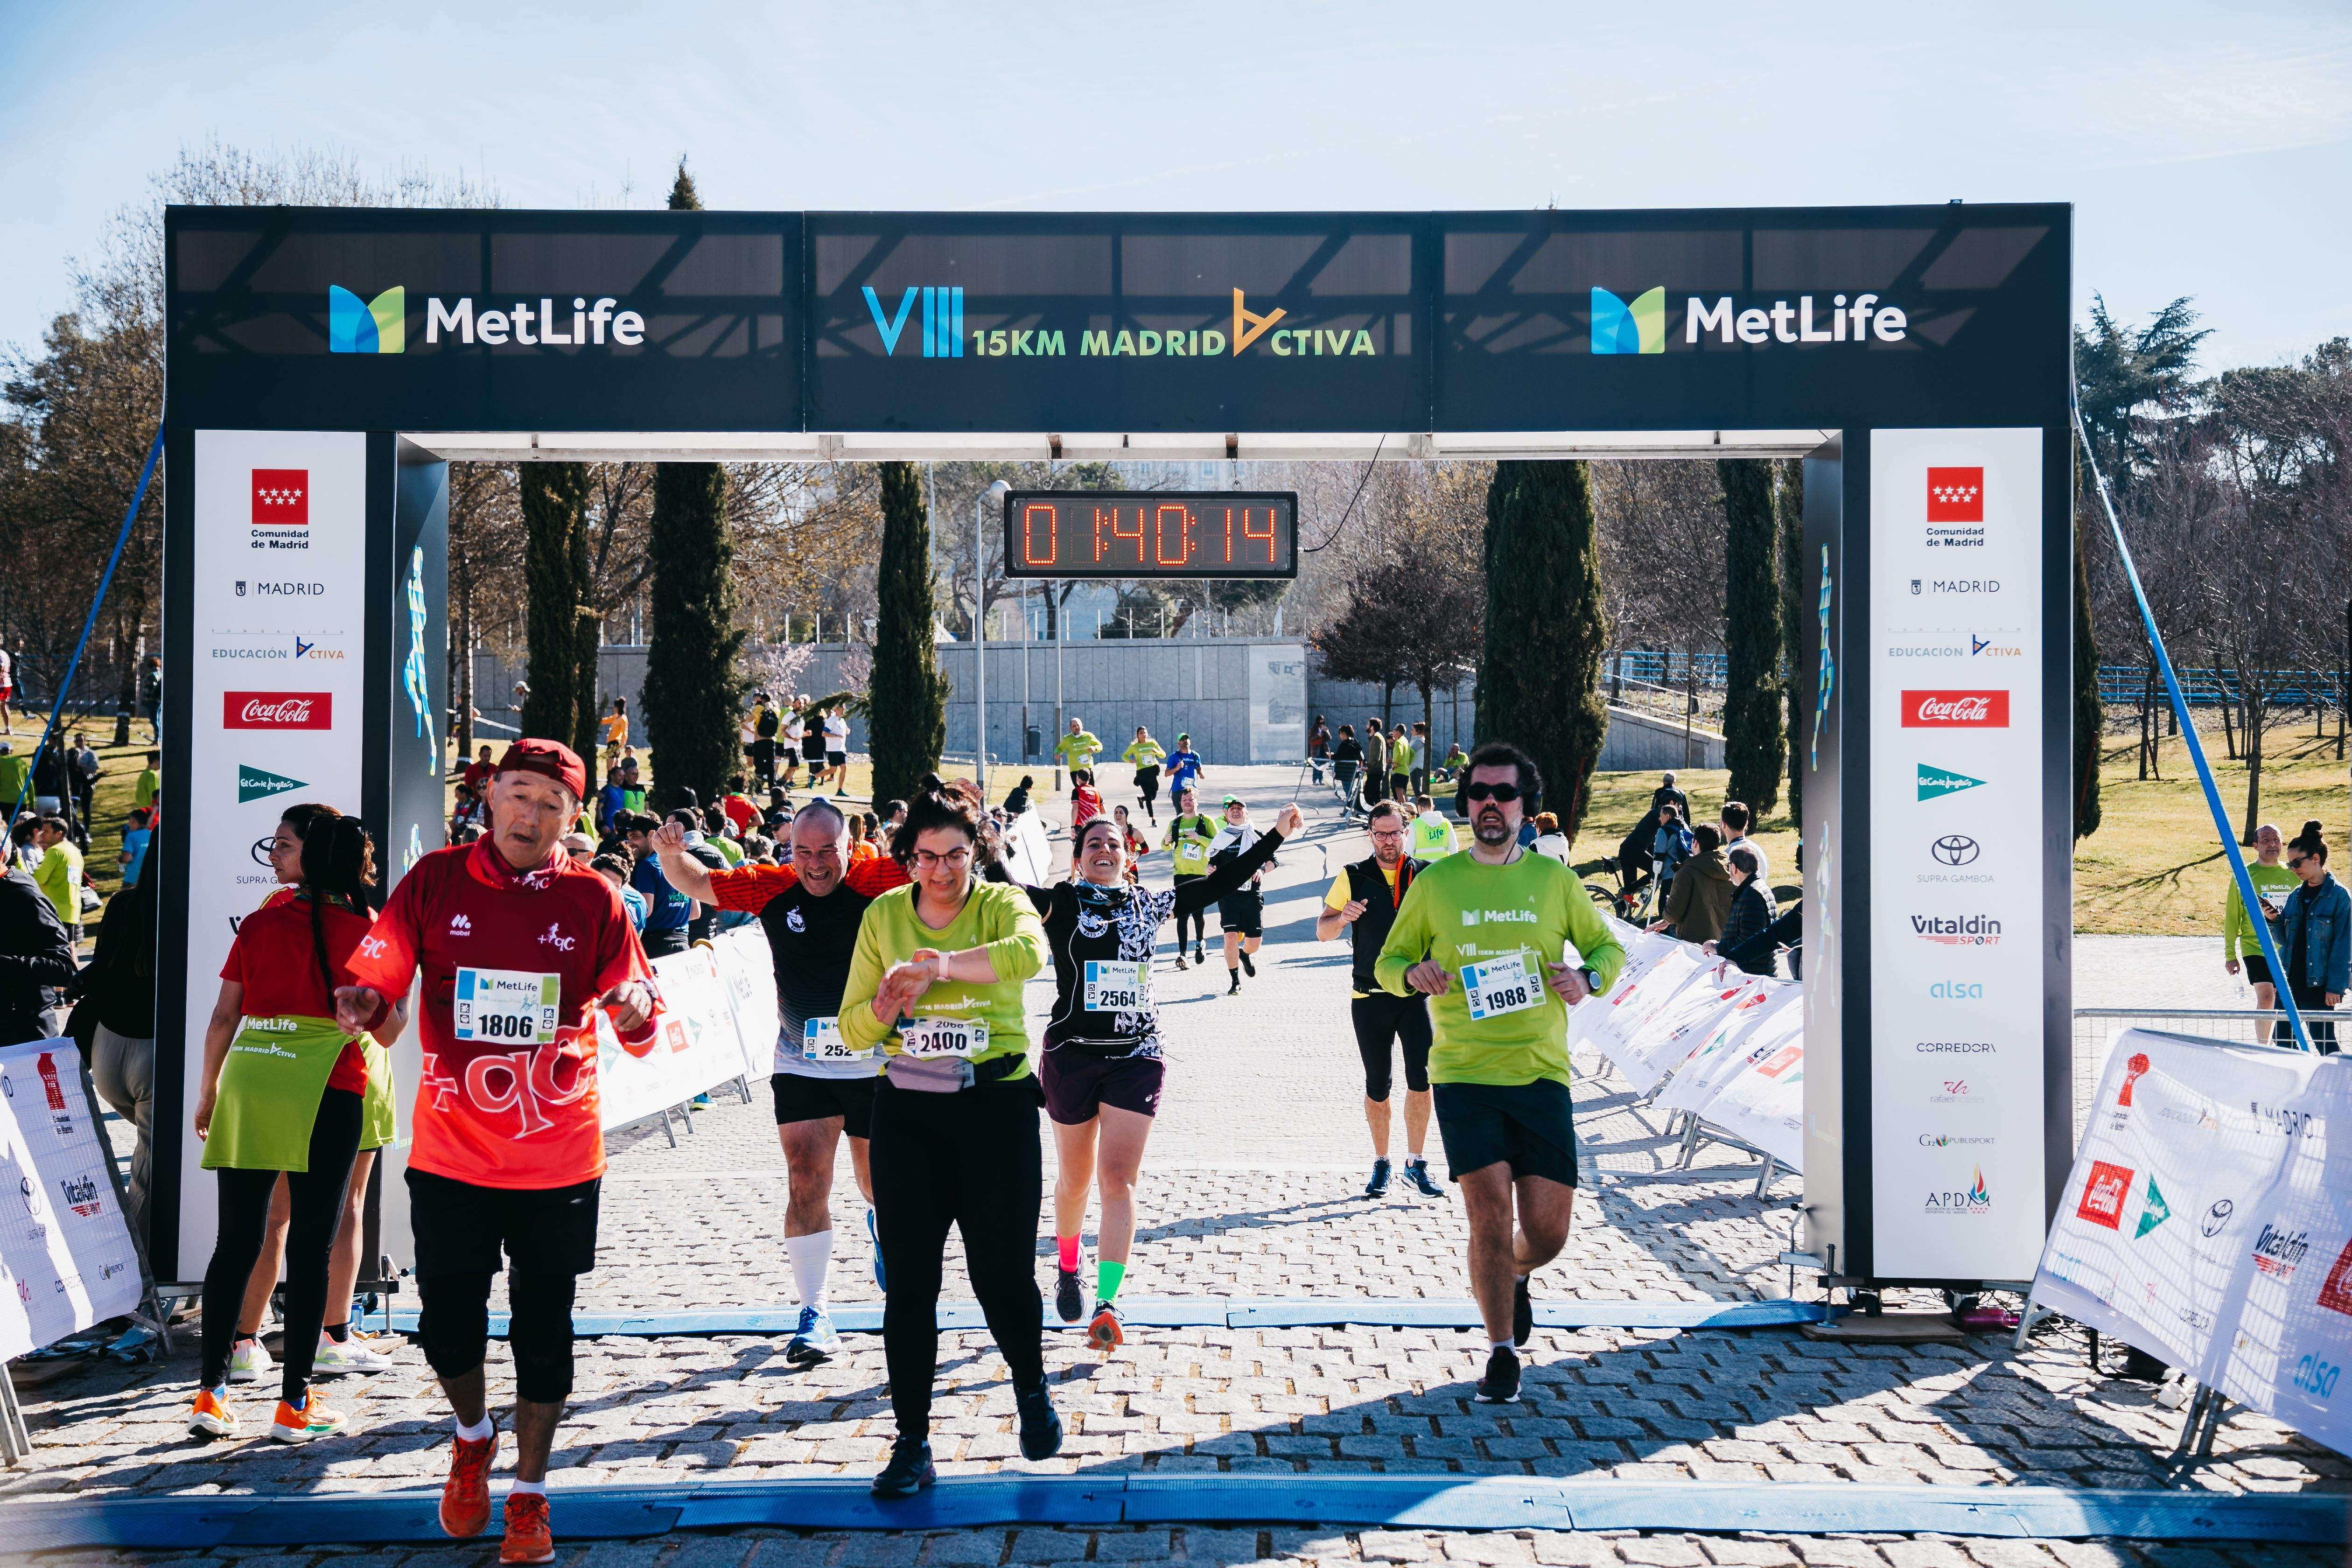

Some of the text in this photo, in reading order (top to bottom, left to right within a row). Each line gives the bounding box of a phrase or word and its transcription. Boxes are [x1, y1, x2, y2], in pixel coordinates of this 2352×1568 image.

[426, 298, 645, 344] MetLife
[861, 287, 963, 357] VIII
[972, 330, 1065, 356] 15KM
[1080, 330, 1225, 357] MADRID
[1686, 294, 1907, 343] MetLife
[251, 530, 308, 538] Comunidad
[251, 540, 308, 549] de Madrid
[258, 582, 324, 595] MADRID
[1933, 580, 2000, 593] MADRID
[212, 647, 287, 658] EDUCACIÓN
[1889, 645, 1963, 657] EDUCACIÓN
[242, 699, 314, 722] Coca-Cola
[1918, 697, 1991, 721] Coca-Cola
[240, 777, 294, 790] El Corte Inglés
[1919, 777, 1927, 786] El
[1927, 777, 1945, 786] Corte
[1484, 910, 1538, 923] MetLife
[1911, 915, 2001, 934] Vitaldin
[1959, 936, 2001, 945] SPORT
[1456, 943, 1477, 956] VIII
[1491, 961, 1521, 973] MetLife
[497, 981, 538, 992] MetLife
[1930, 980, 1982, 999] alsa
[1100, 990, 1136, 1007] 2564
[1485, 987, 1527, 1010] 1988
[247, 1018, 297, 1031] MetLife
[478, 1015, 533, 1038] 1806
[920, 1032, 967, 1051] 2400
[2255, 1224, 2309, 1264] Vitaldin
[2294, 1351, 2341, 1400] alsa
